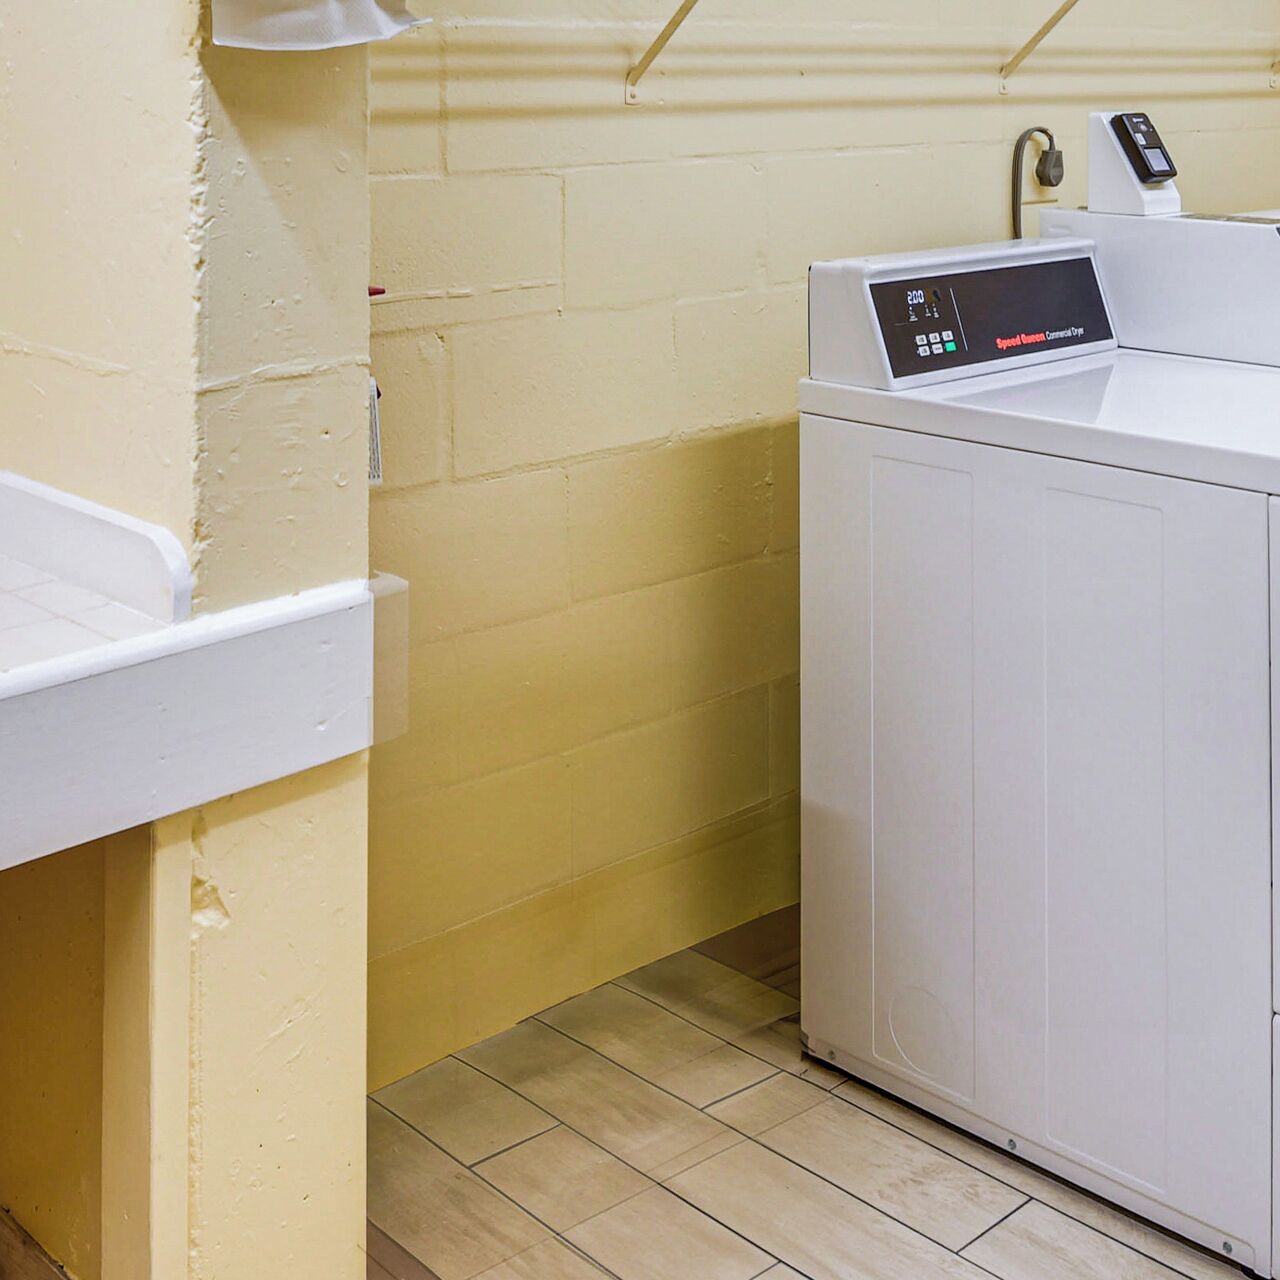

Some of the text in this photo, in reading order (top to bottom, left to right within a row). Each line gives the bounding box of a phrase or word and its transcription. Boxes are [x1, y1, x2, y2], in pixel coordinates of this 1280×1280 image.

[996, 326, 1084, 350] Speed Queen Commercial Dryer
